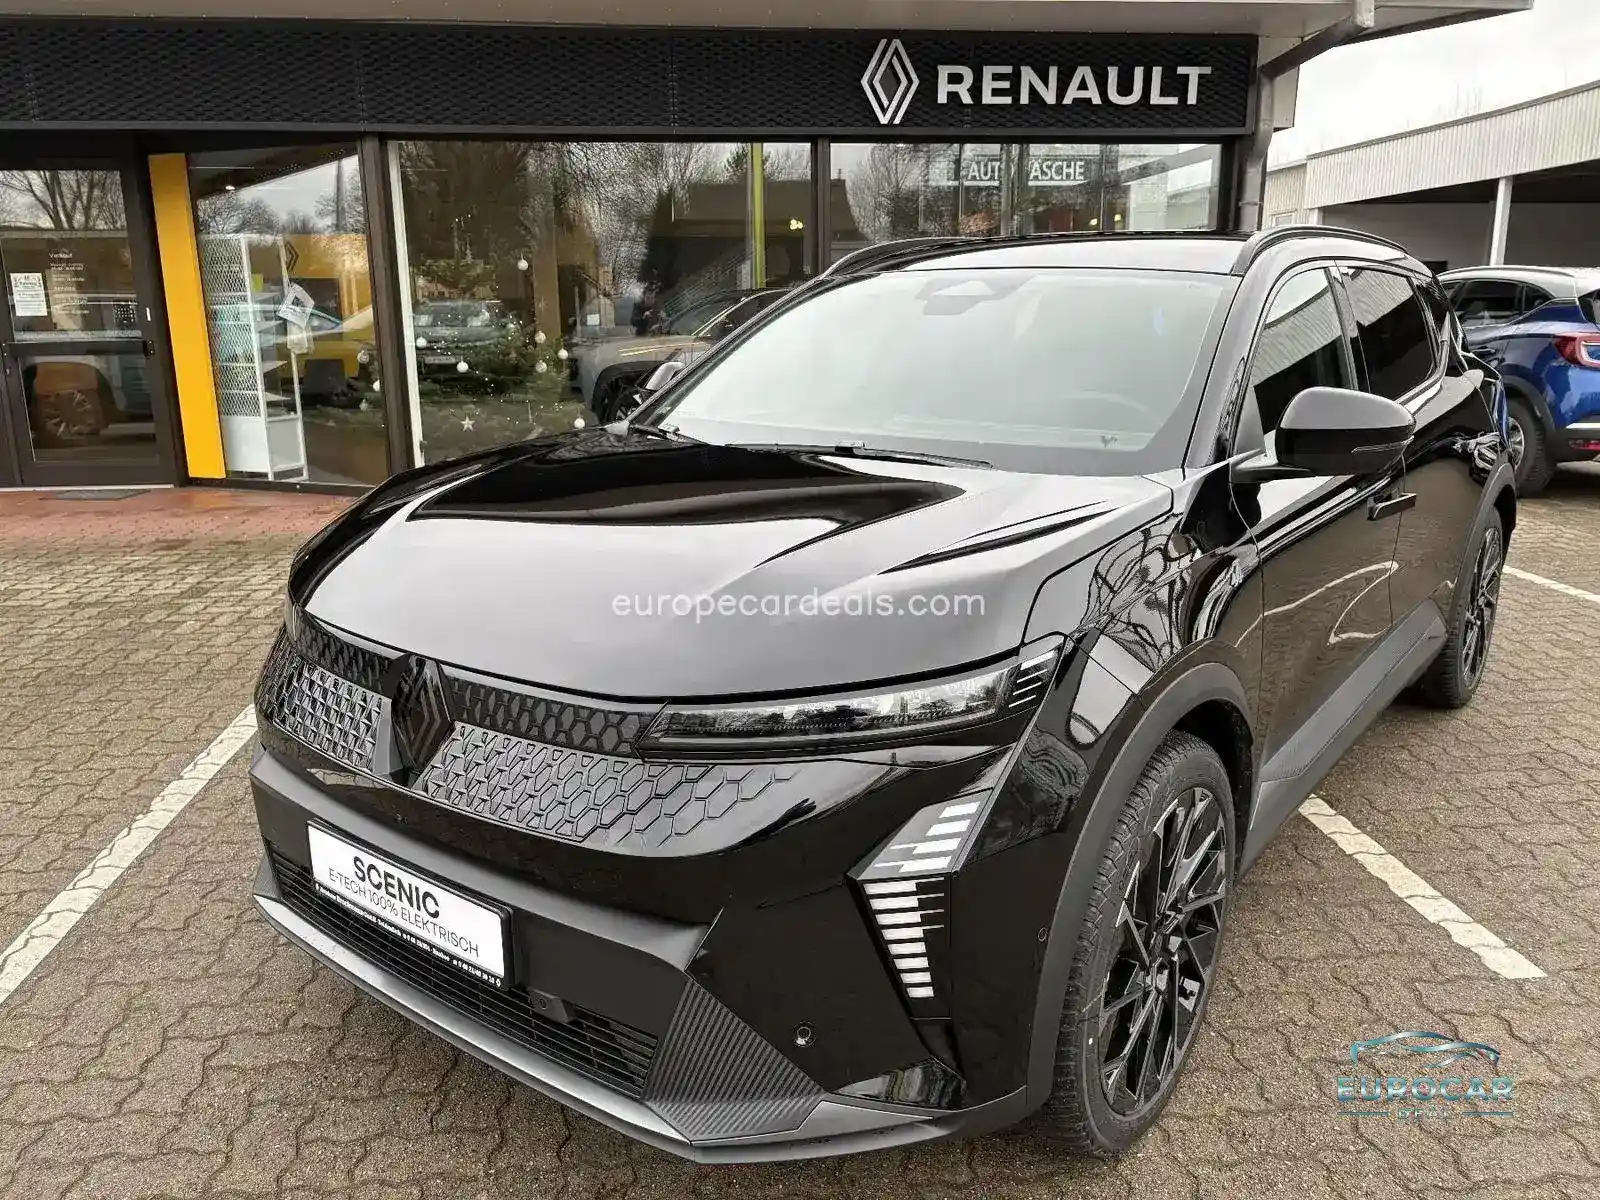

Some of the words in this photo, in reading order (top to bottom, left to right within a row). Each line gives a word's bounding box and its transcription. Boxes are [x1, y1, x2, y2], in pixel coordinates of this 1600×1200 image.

[937, 64, 1212, 106] RENAULT
[328, 866, 367, 901] E-TECH
[368, 887, 399, 918] 100%
[400, 906, 480, 959] ELEKTRISCH
[353, 856, 440, 919] SCENIC
